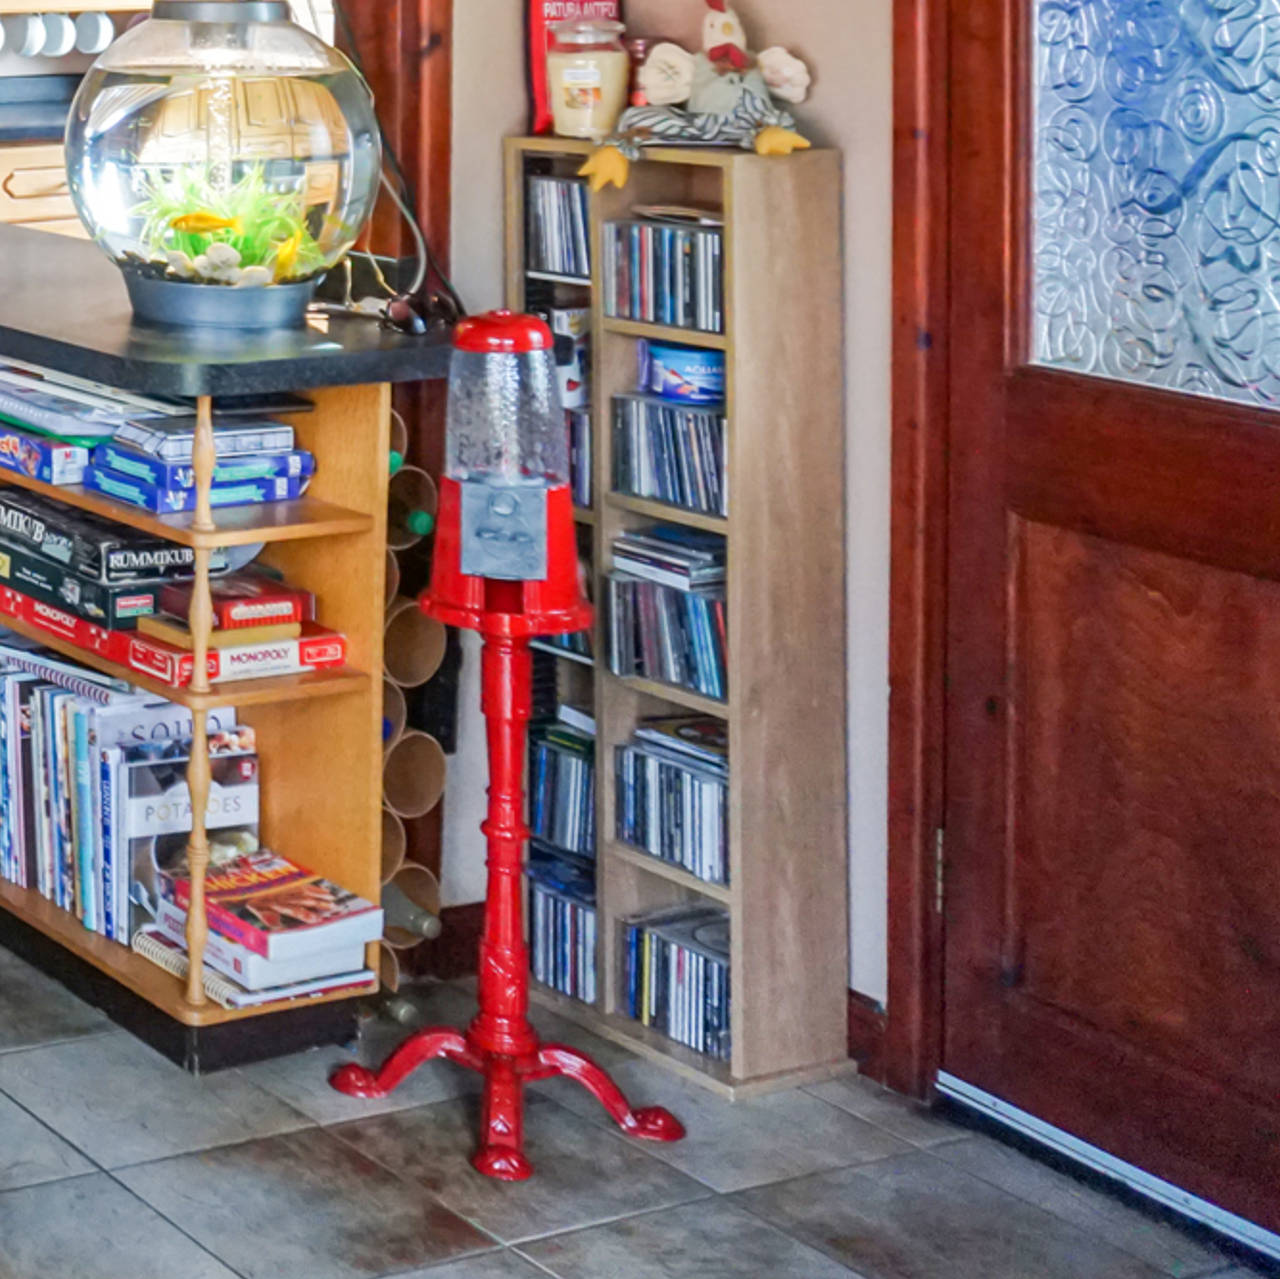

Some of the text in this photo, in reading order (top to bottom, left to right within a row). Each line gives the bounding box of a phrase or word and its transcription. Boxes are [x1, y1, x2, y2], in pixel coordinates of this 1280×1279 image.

[109, 548, 195, 570] RUMMIKUB
[33, 602, 78, 629] MONOPOLY
[229, 647, 290, 666] MONOPOLY
[144, 795, 242, 822] POTAOES
